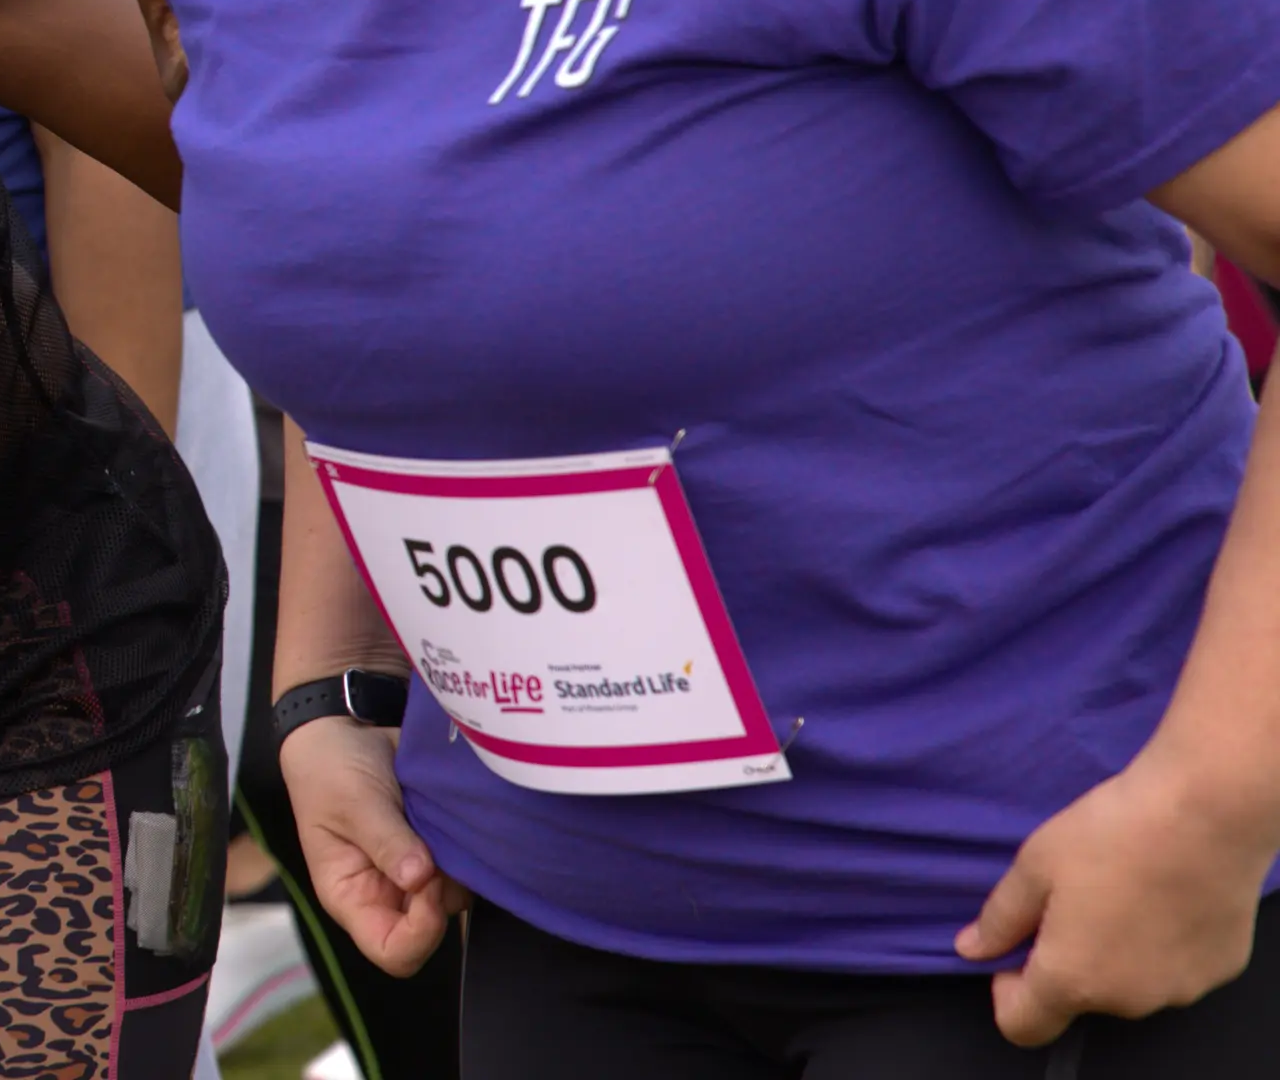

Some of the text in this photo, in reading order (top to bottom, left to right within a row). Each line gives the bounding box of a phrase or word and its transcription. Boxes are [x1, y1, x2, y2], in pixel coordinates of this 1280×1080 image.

[402, 538, 598, 615] 5000
[463, 670, 490, 698] for
[489, 669, 544, 705] Life
[553, 671, 691, 699] Standard Life
